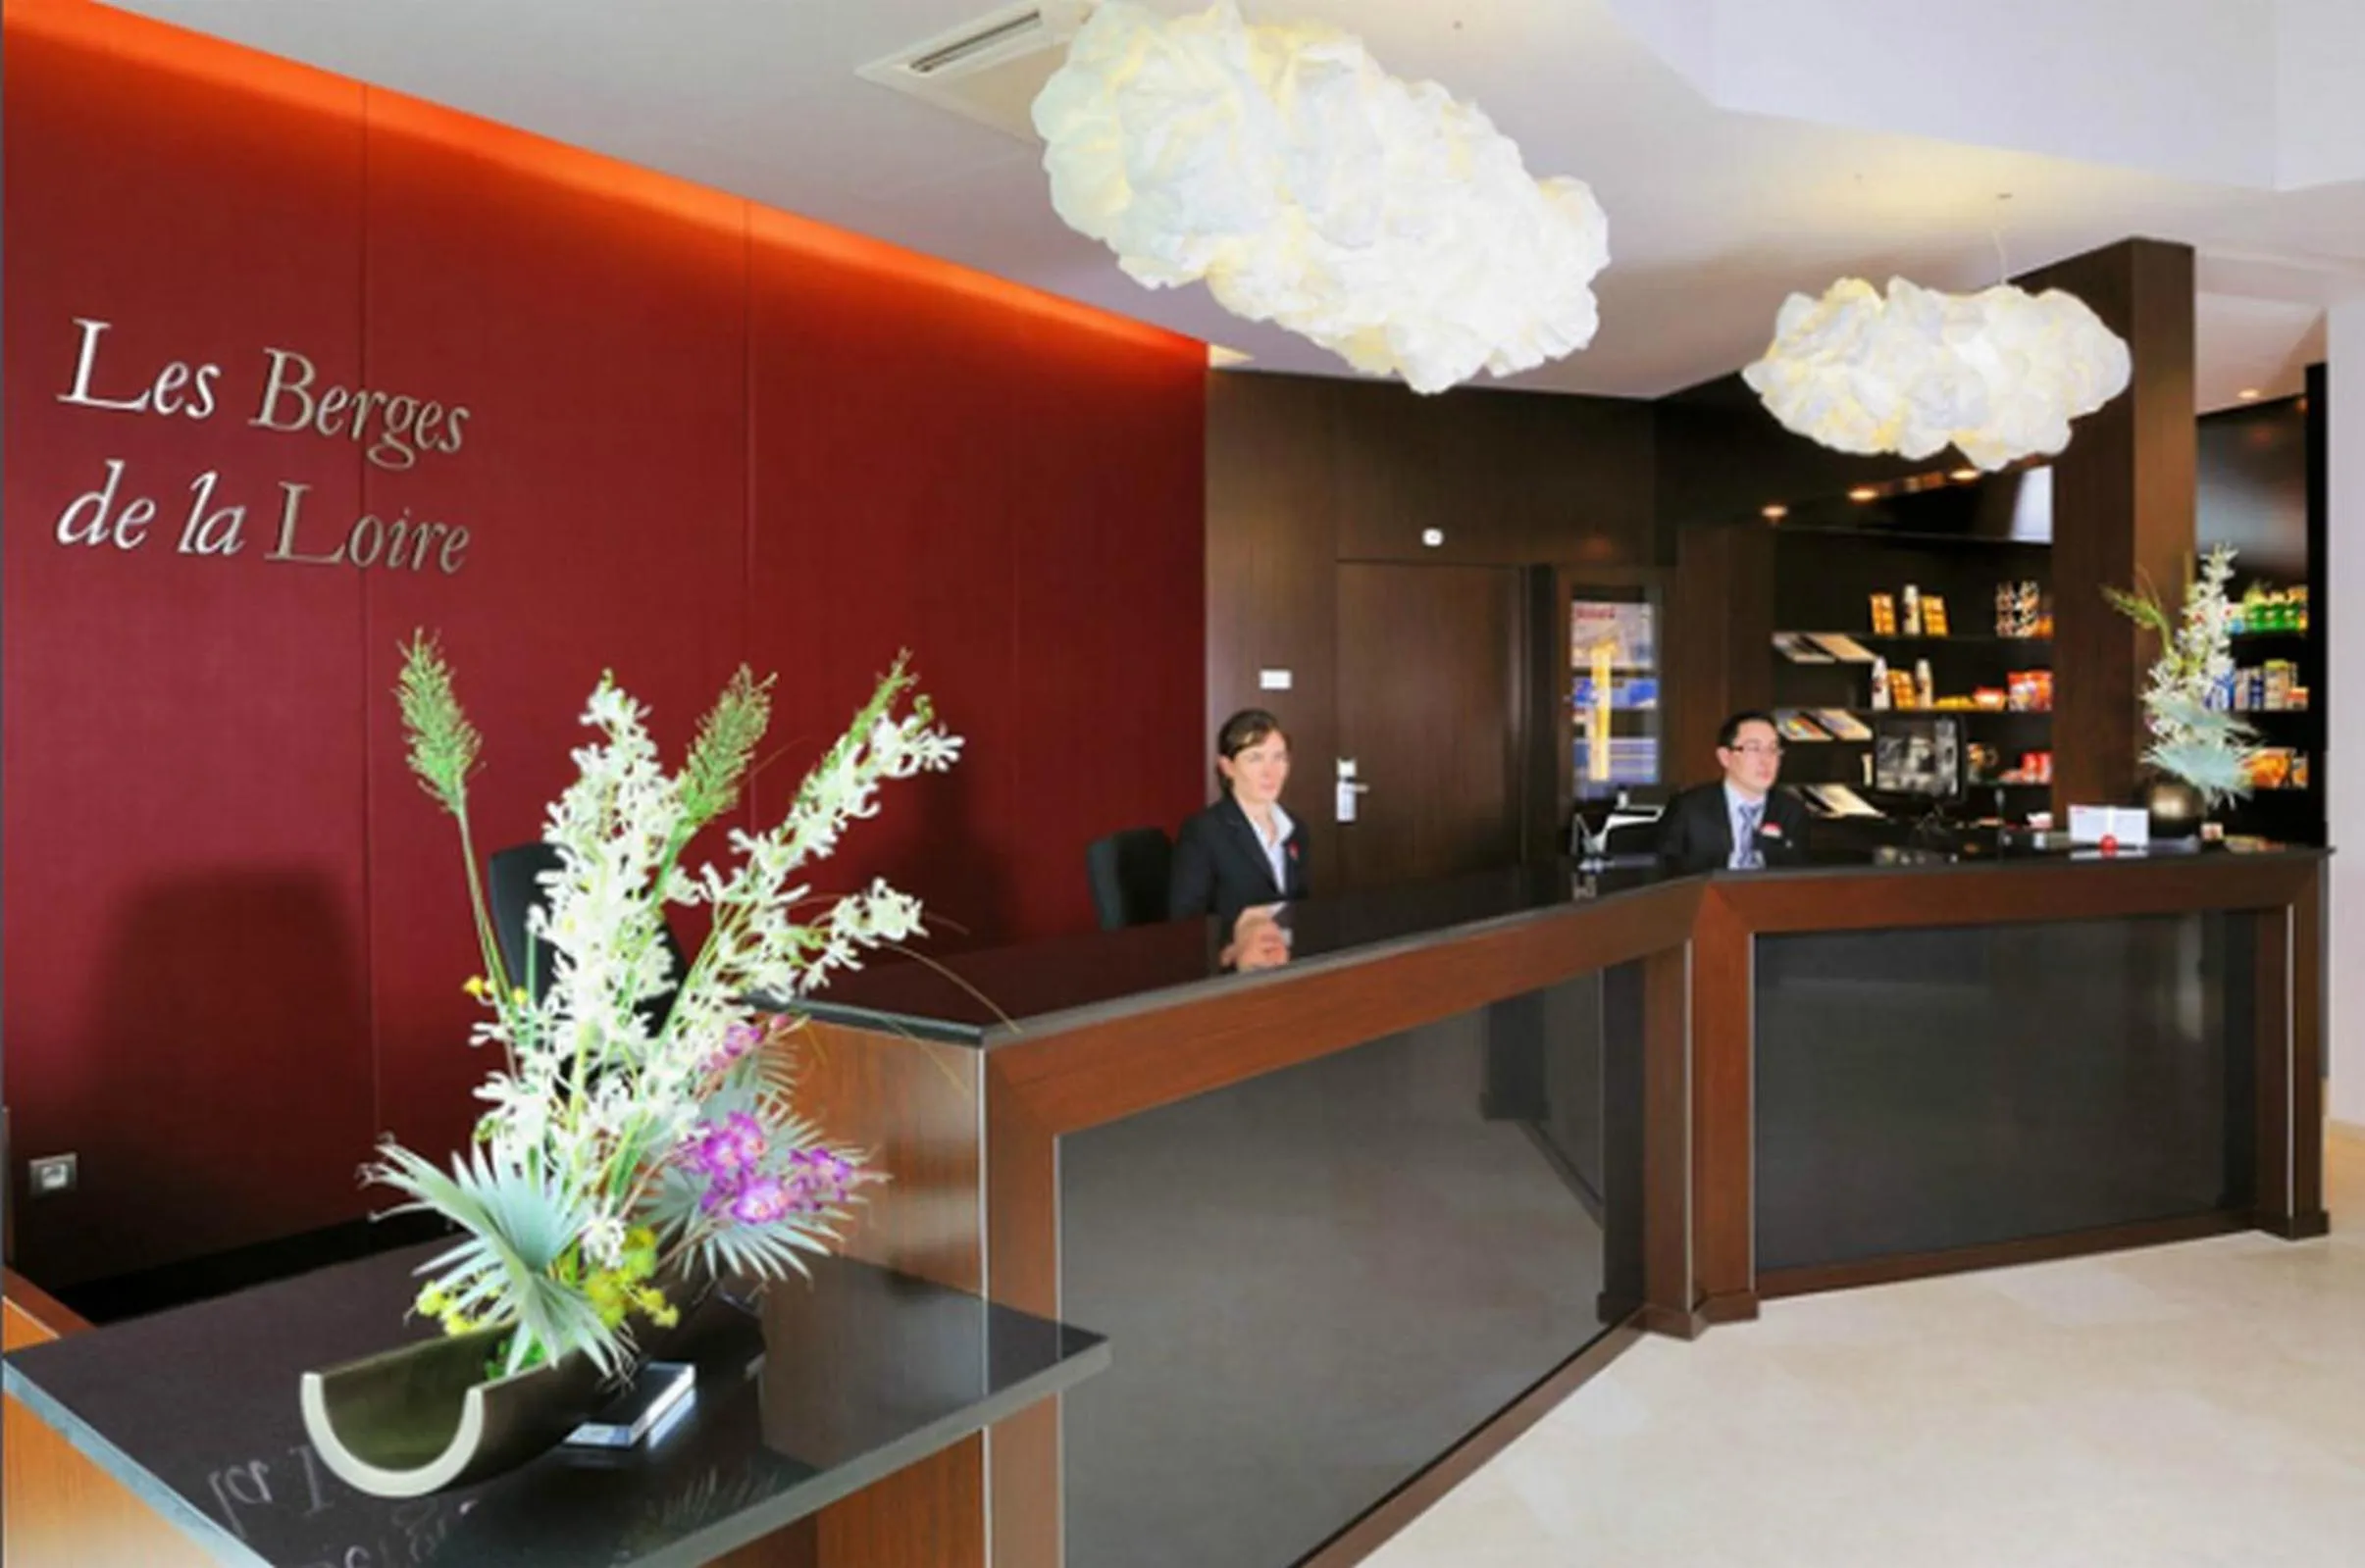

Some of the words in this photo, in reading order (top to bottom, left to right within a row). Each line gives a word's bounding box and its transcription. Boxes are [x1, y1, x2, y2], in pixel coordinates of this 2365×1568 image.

[57, 318, 222, 419] Les
[248, 346, 471, 470] Berges
[56, 459, 157, 550] de
[177, 470, 247, 555] la
[264, 481, 470, 574] Loire
